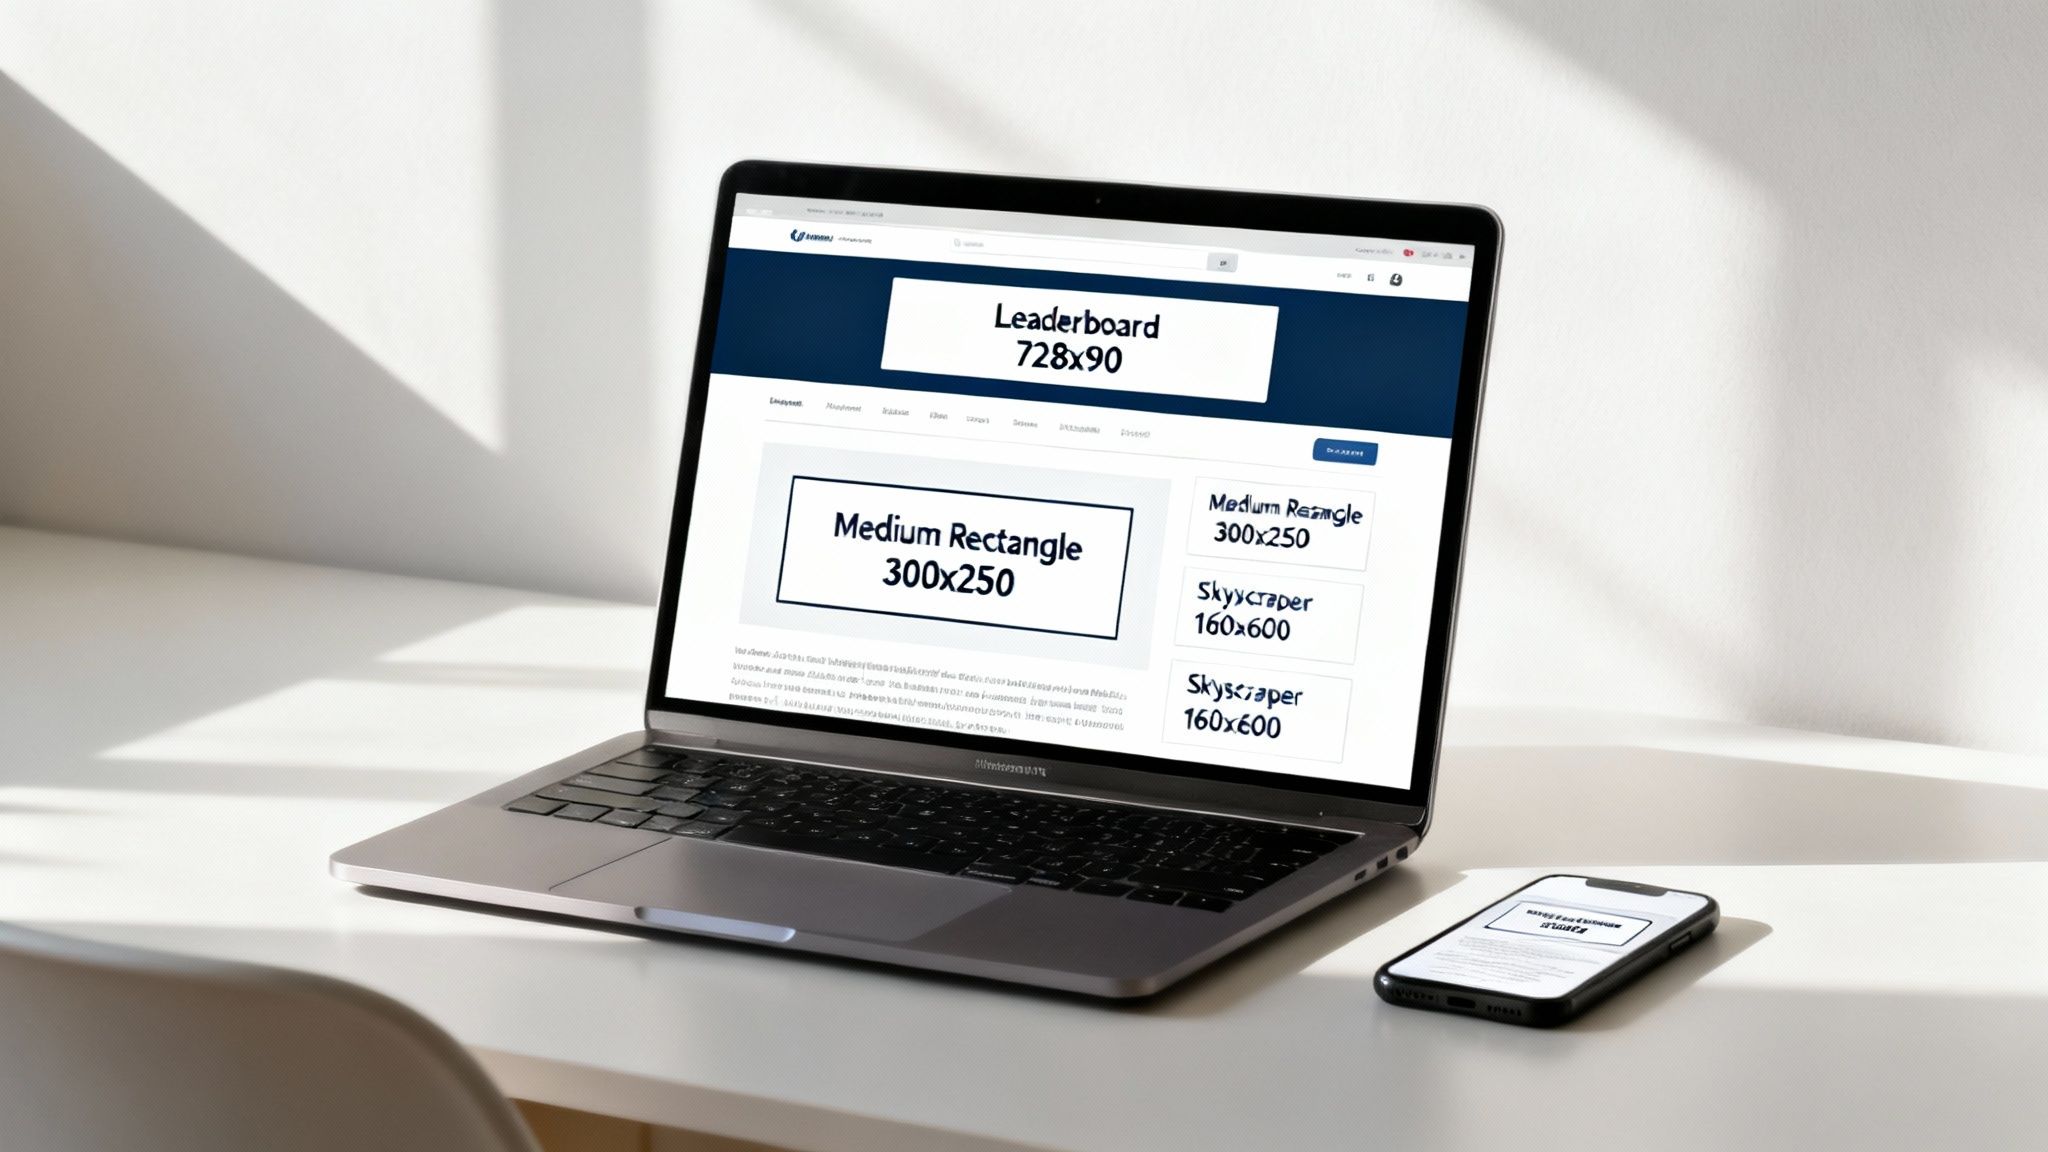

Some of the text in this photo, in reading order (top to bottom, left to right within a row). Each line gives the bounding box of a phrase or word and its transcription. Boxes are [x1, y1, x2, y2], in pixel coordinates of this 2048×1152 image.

[995, 303, 1160, 339] Leaderboard
[1017, 340, 1122, 374] 728x90
[833, 512, 1083, 566] Medium Rectangle
[1213, 521, 1311, 549] 300x250
[883, 558, 1015, 597] 300x250
[1195, 611, 1291, 641] 160x600
[1184, 707, 1282, 739] 160x600
